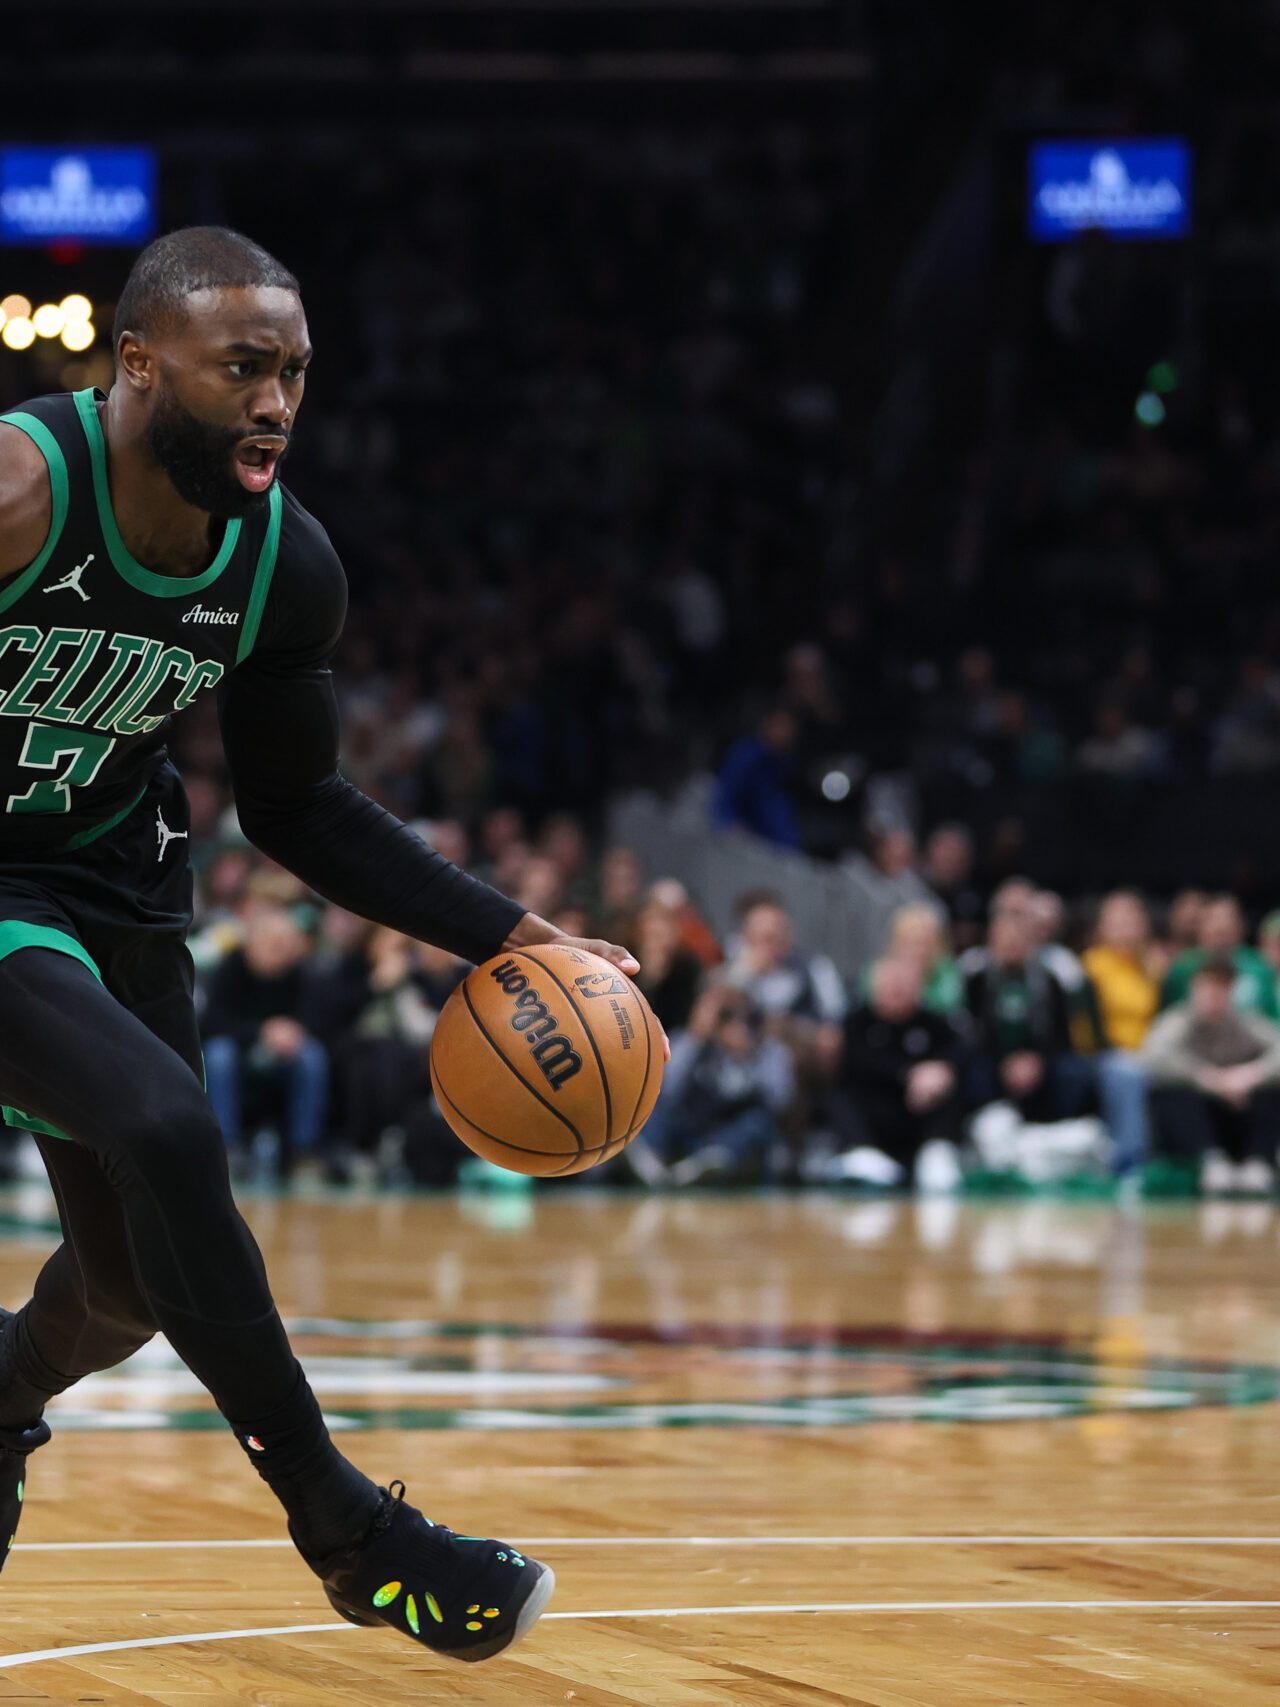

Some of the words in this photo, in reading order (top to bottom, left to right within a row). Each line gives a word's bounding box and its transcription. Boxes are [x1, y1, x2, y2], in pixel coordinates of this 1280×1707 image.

[181, 603, 240, 625] Amica
[6, 722, 117, 813] 7
[490, 959, 582, 1092] Wilson
